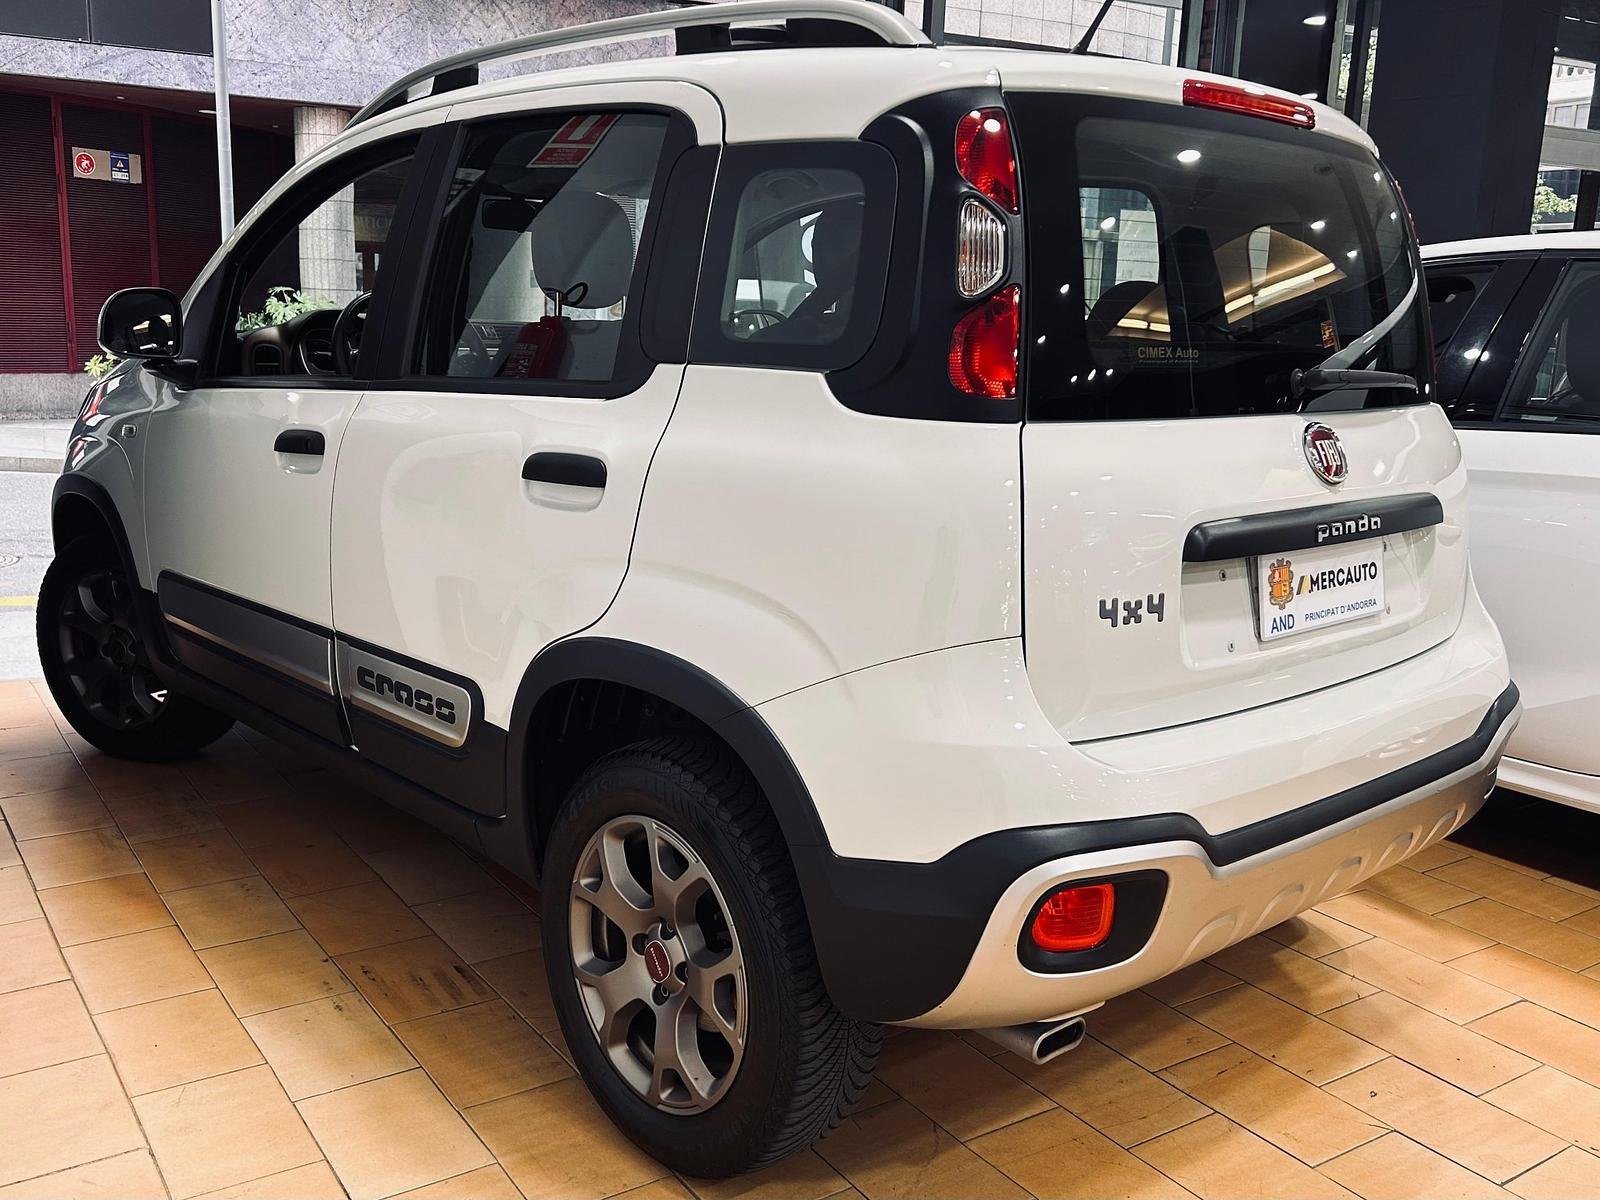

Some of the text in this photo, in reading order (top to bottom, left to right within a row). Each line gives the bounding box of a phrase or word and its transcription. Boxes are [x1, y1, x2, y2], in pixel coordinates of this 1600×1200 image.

[1137, 346, 1199, 358] CIMEX Auto
[1315, 439, 1341, 467] FIAT
[1309, 561, 1378, 594] MERCAUTO
[1099, 592, 1165, 628] 4x4
[1304, 598, 1378, 623] PRINCIPAT D'ANDORRA
[1270, 613, 1296, 635] AND
